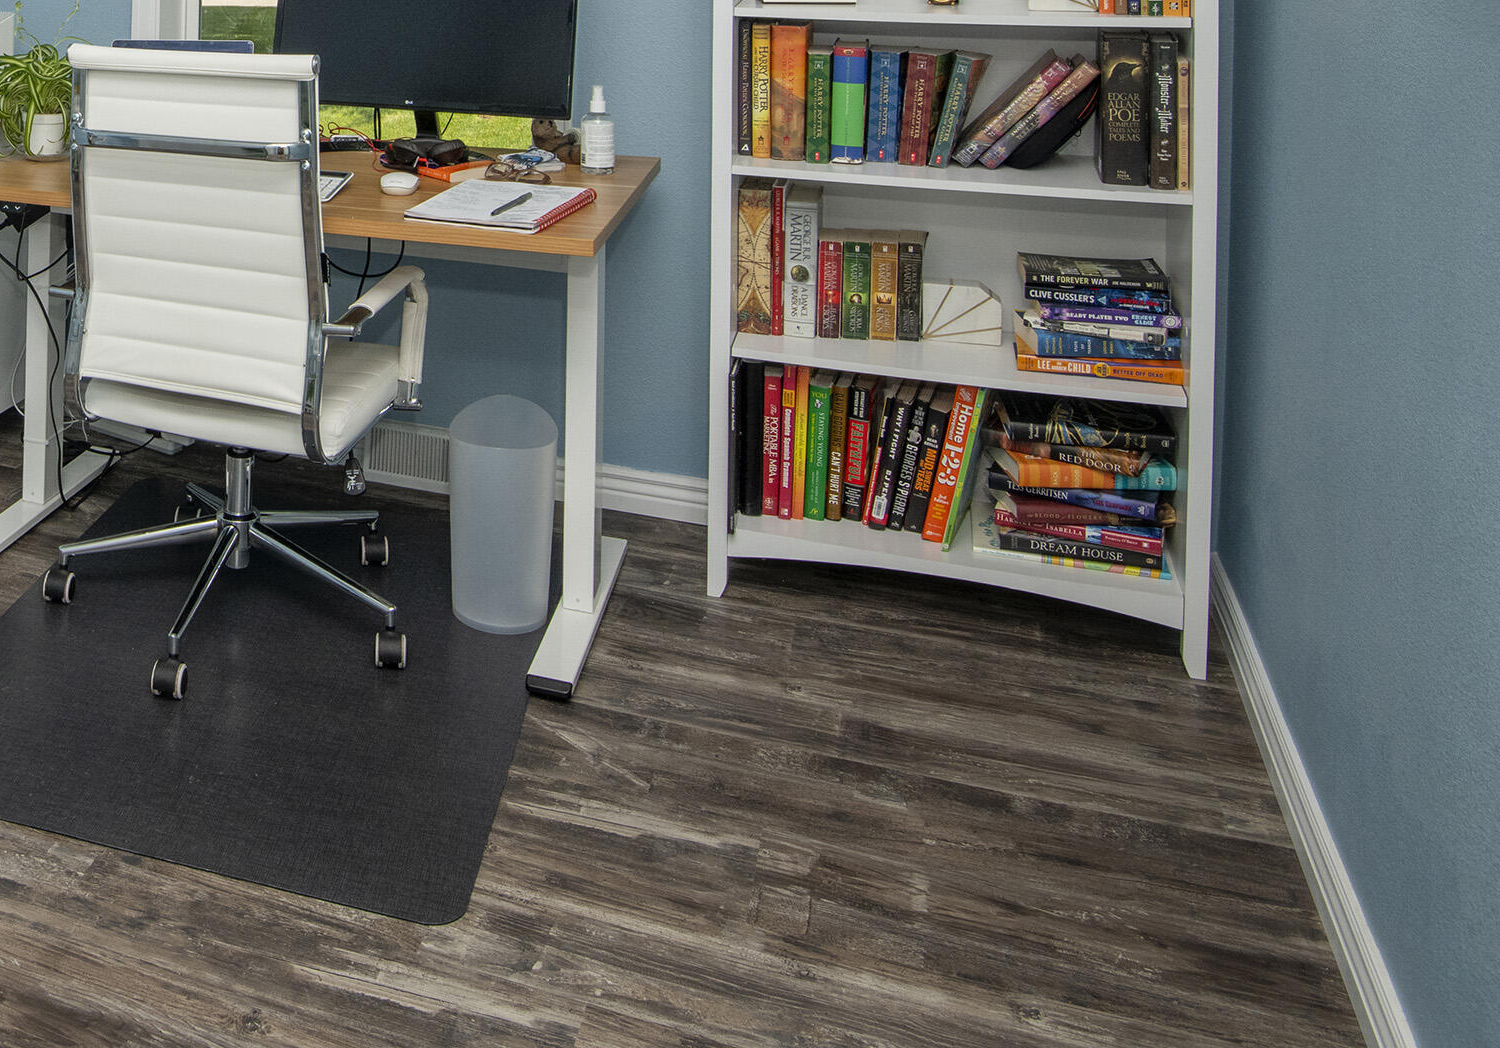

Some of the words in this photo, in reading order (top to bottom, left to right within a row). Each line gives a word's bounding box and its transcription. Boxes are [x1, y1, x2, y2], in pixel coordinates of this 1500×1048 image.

[759, 46, 768, 77] HARRY
[759, 79, 767, 112] POTTER
[917, 79, 925, 107] HARRY
[951, 82, 963, 112] HARRY
[1108, 100, 1140, 108] ALLAN
[1109, 109, 1140, 121] POE
[943, 114, 955, 142] POTTER
[1109, 133, 1140, 141] POEMS
[790, 214, 802, 261] MARTIN
[803, 214, 812, 247] GEORGE
[903, 264, 911, 292] MARTIN
[1040, 275, 1054, 283] THE
[1057, 275, 1089, 285] FOREVER
[1091, 277, 1108, 286] WAR
[1029, 289, 1052, 299] CLIVE
[1054, 291, 1095, 303] CUSSLER'S
[876, 307, 884, 331] KINGS
[1037, 360, 1050, 369] LEE
[1068, 362, 1091, 373] CHILD
[811, 391, 827, 399] YOU
[835, 393, 844, 414] DAVID
[783, 409, 792, 436] Complete
[896, 407, 905, 427] WHY
[948, 401, 961, 440] Improvement
[954, 404, 973, 444] Home
[770, 417, 778, 457] PORTABLE
[889, 433, 899, 460] FIGHT
[783, 438, 791, 460] Spanish
[847, 421, 863, 482] FAITHFUL
[768, 459, 777, 477] MBA
[830, 451, 841, 472] CAN'T
[900, 443, 918, 480] GEORGES
[937, 442, 964, 487] 1-2-3
[1059, 453, 1082, 464] RED
[1085, 459, 1122, 472] DOOR
[782, 462, 790, 488] Grammar
[829, 474, 840, 493] HURT
[885, 469, 892, 480] BJ
[828, 495, 839, 505] ME
[1026, 485, 1068, 500] GERRITSEN
[1045, 521, 1082, 536] ISABELLA
[1030, 540, 1077, 555] DREAM
[1081, 548, 1124, 562] HOUSE
